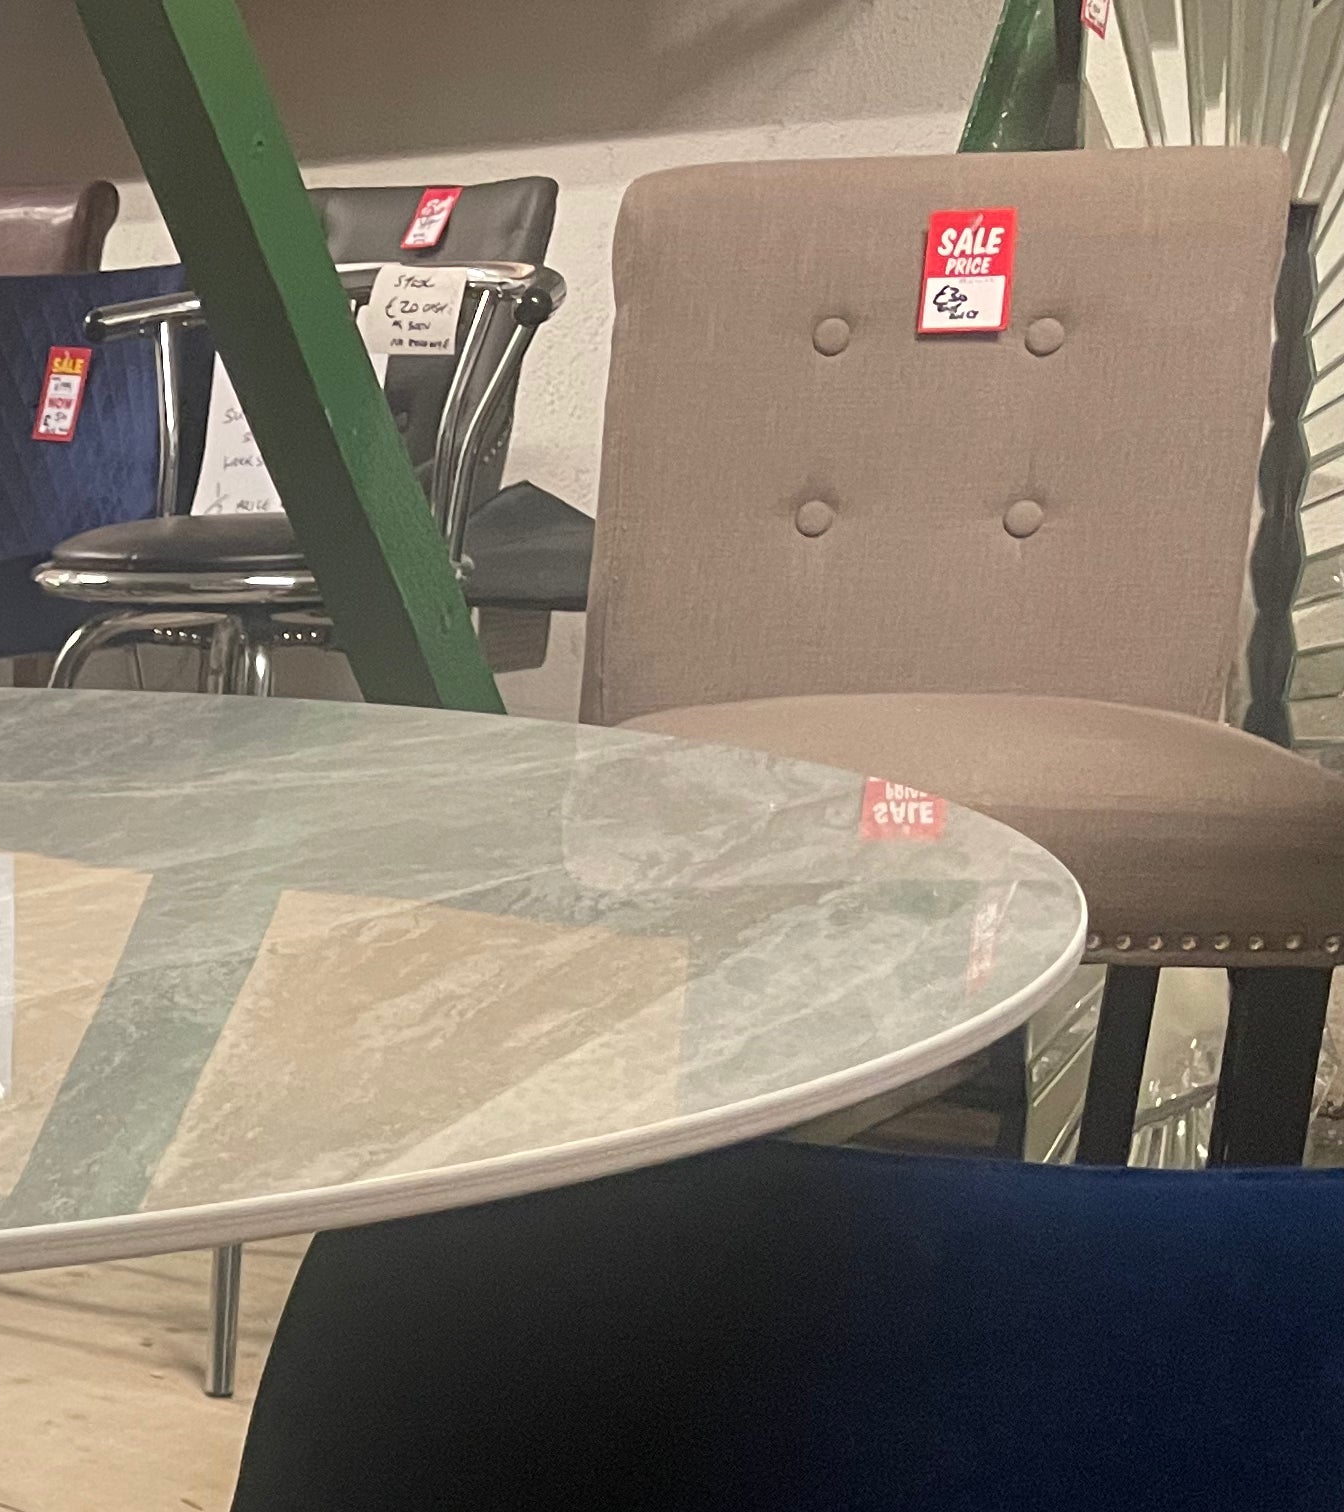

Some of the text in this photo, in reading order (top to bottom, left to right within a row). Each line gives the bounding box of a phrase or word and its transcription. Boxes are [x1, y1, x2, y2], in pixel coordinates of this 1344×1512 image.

[937, 227, 1005, 257] SALE
[945, 257, 992, 275] PRICE
[52, 357, 84, 374] SALE
